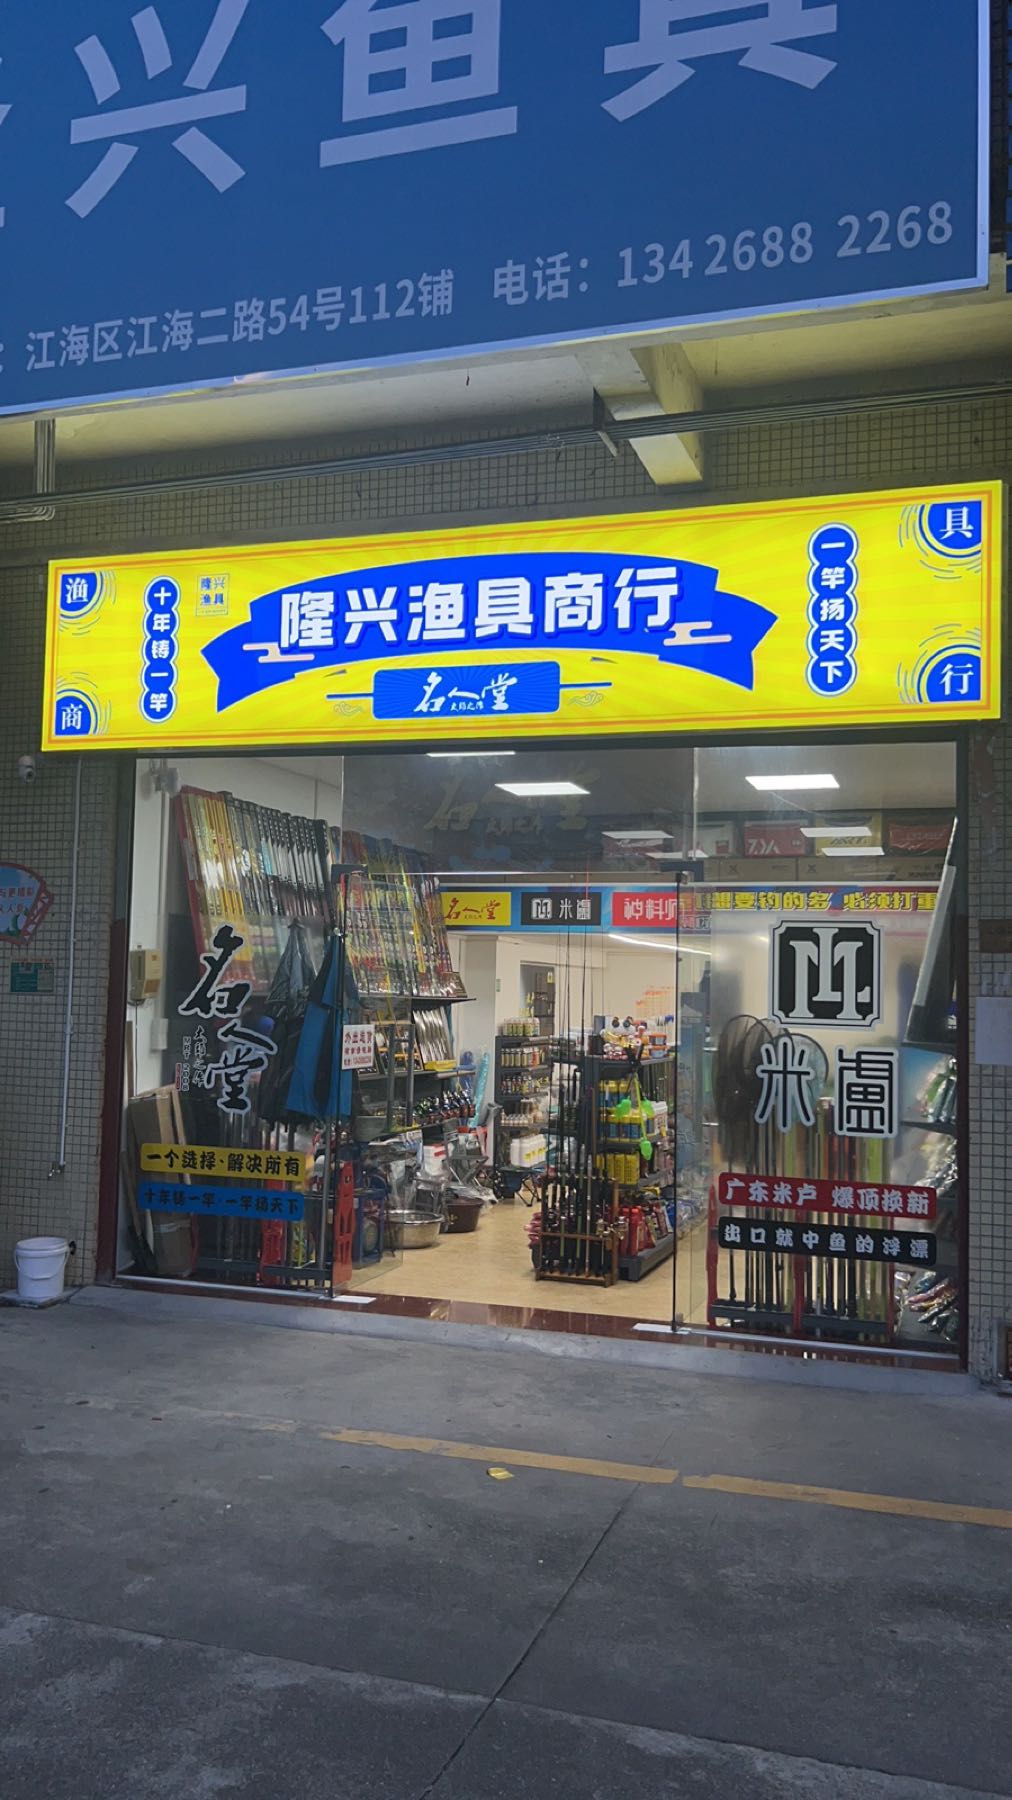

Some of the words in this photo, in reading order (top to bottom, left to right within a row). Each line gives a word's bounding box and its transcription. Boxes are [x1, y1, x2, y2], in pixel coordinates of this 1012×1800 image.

[0, 0, 838, 219] 兴鱼具
[26, 269, 455, 372] 江海区江海二路54号112铺
[616, 239, 694, 287] 134
[703, 221, 814, 276] 2688
[836, 200, 954, 258] 2268
[940, 506, 974, 540] 具
[65, 576, 89, 605] 渔
[280, 566, 679, 650] 隆兴渔具商行
[819, 541, 846, 684] 一竿扬天下
[149, 586, 172, 713] 十年铸一竿
[413, 671, 518, 713] 名人堂
[938, 662, 975, 696] 行
[60, 702, 84, 731] 商
[178, 924, 279, 1114] 名人堂
[725, 1177, 818, 1206] 广东米卢
[831, 1185, 930, 1216] 爆顶换新
[723, 1223, 930, 1259] 出口就中鱼的浮漂
